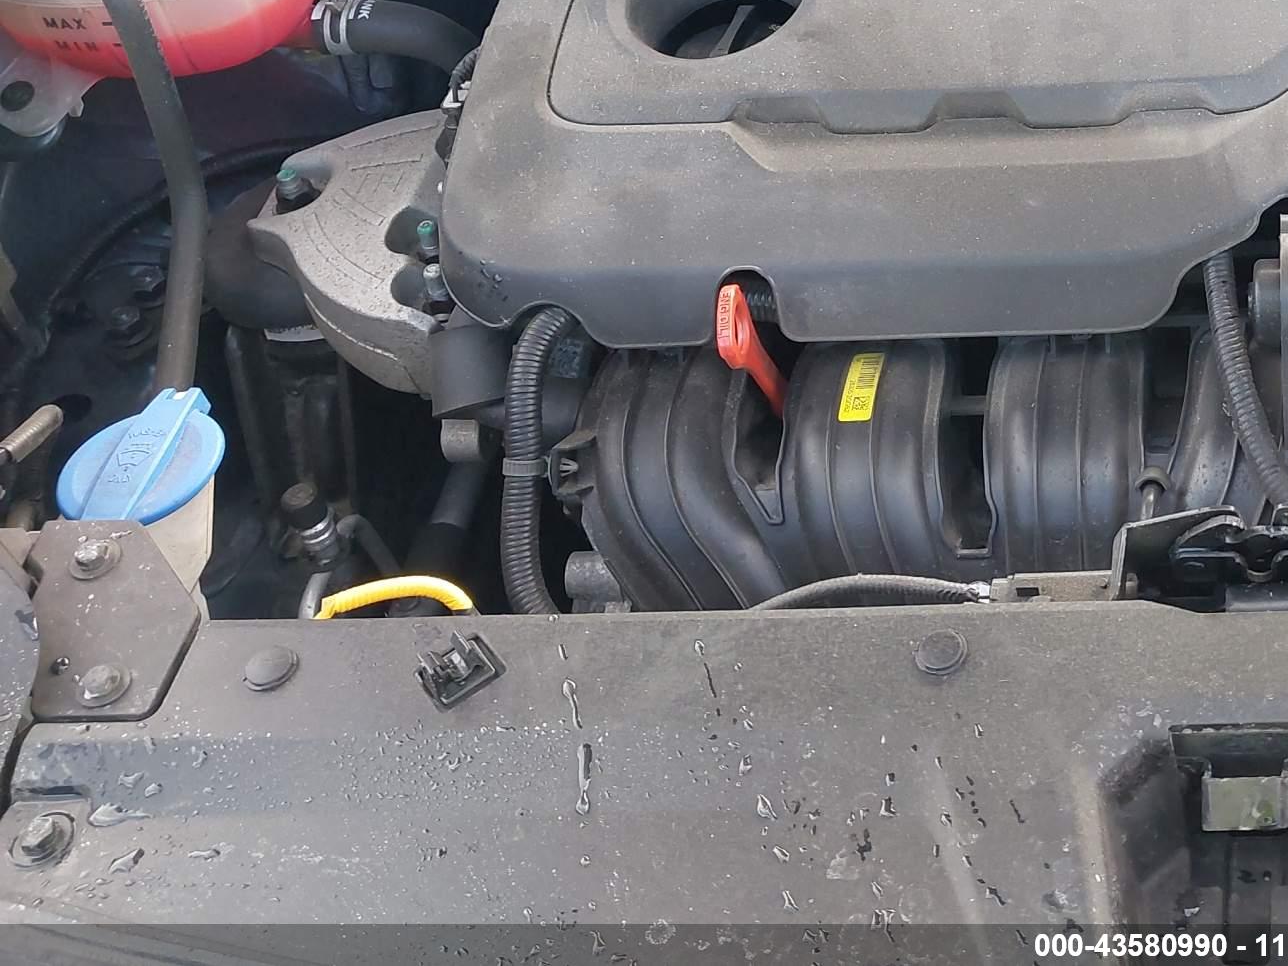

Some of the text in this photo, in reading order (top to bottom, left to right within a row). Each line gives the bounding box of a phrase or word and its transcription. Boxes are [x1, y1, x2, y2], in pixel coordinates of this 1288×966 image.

[42, 17, 87, 30] MAX
[54, 40, 99, 52] MIN
[719, 291, 730, 315] ENG
